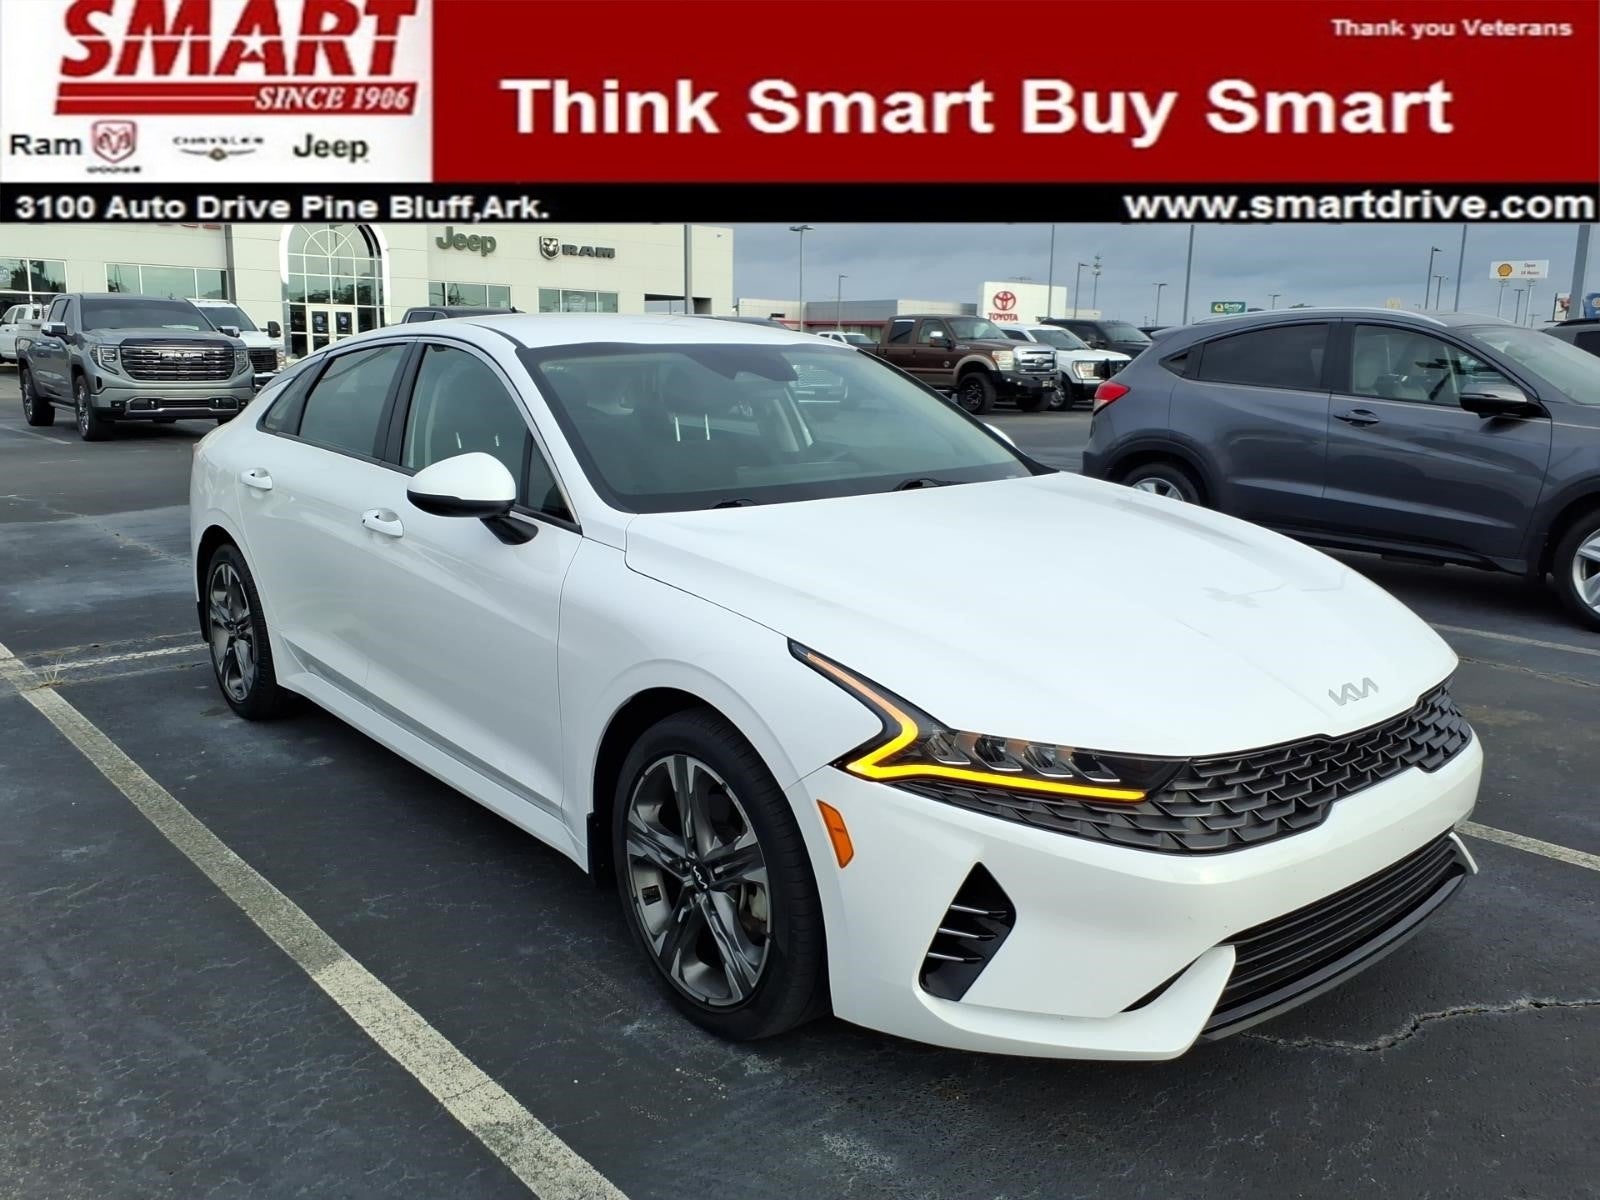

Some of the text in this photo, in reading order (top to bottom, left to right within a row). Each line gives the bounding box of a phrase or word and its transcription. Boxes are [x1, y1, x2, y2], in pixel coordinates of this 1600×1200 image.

[435, 226, 497, 257] Jeep
[561, 244, 616, 259] RAM
[988, 312, 1018, 321] TOYOTA
